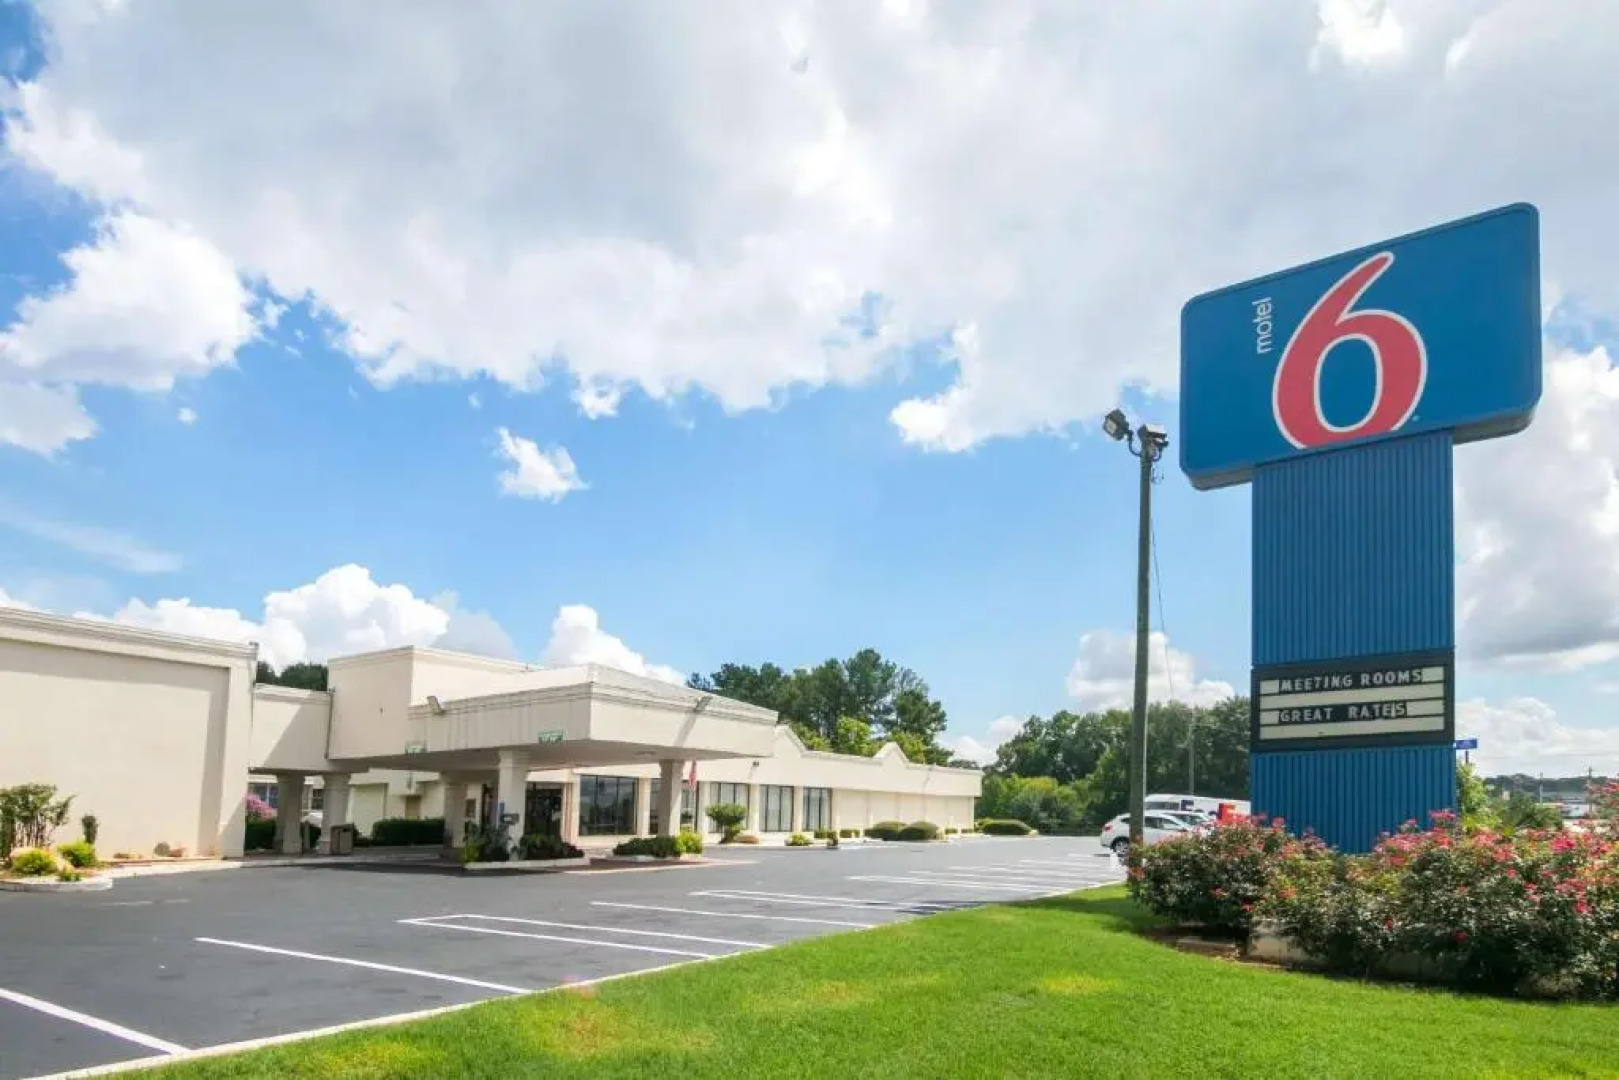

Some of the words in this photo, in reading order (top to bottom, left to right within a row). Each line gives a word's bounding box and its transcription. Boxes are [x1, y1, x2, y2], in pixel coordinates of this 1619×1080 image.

[1252, 297, 1272, 354] motel
[1272, 252, 1427, 449] 6
[1280, 675, 1353, 692] MEETING
[1360, 669, 1422, 686] ROOMS
[1280, 708, 1334, 722] GREAT
